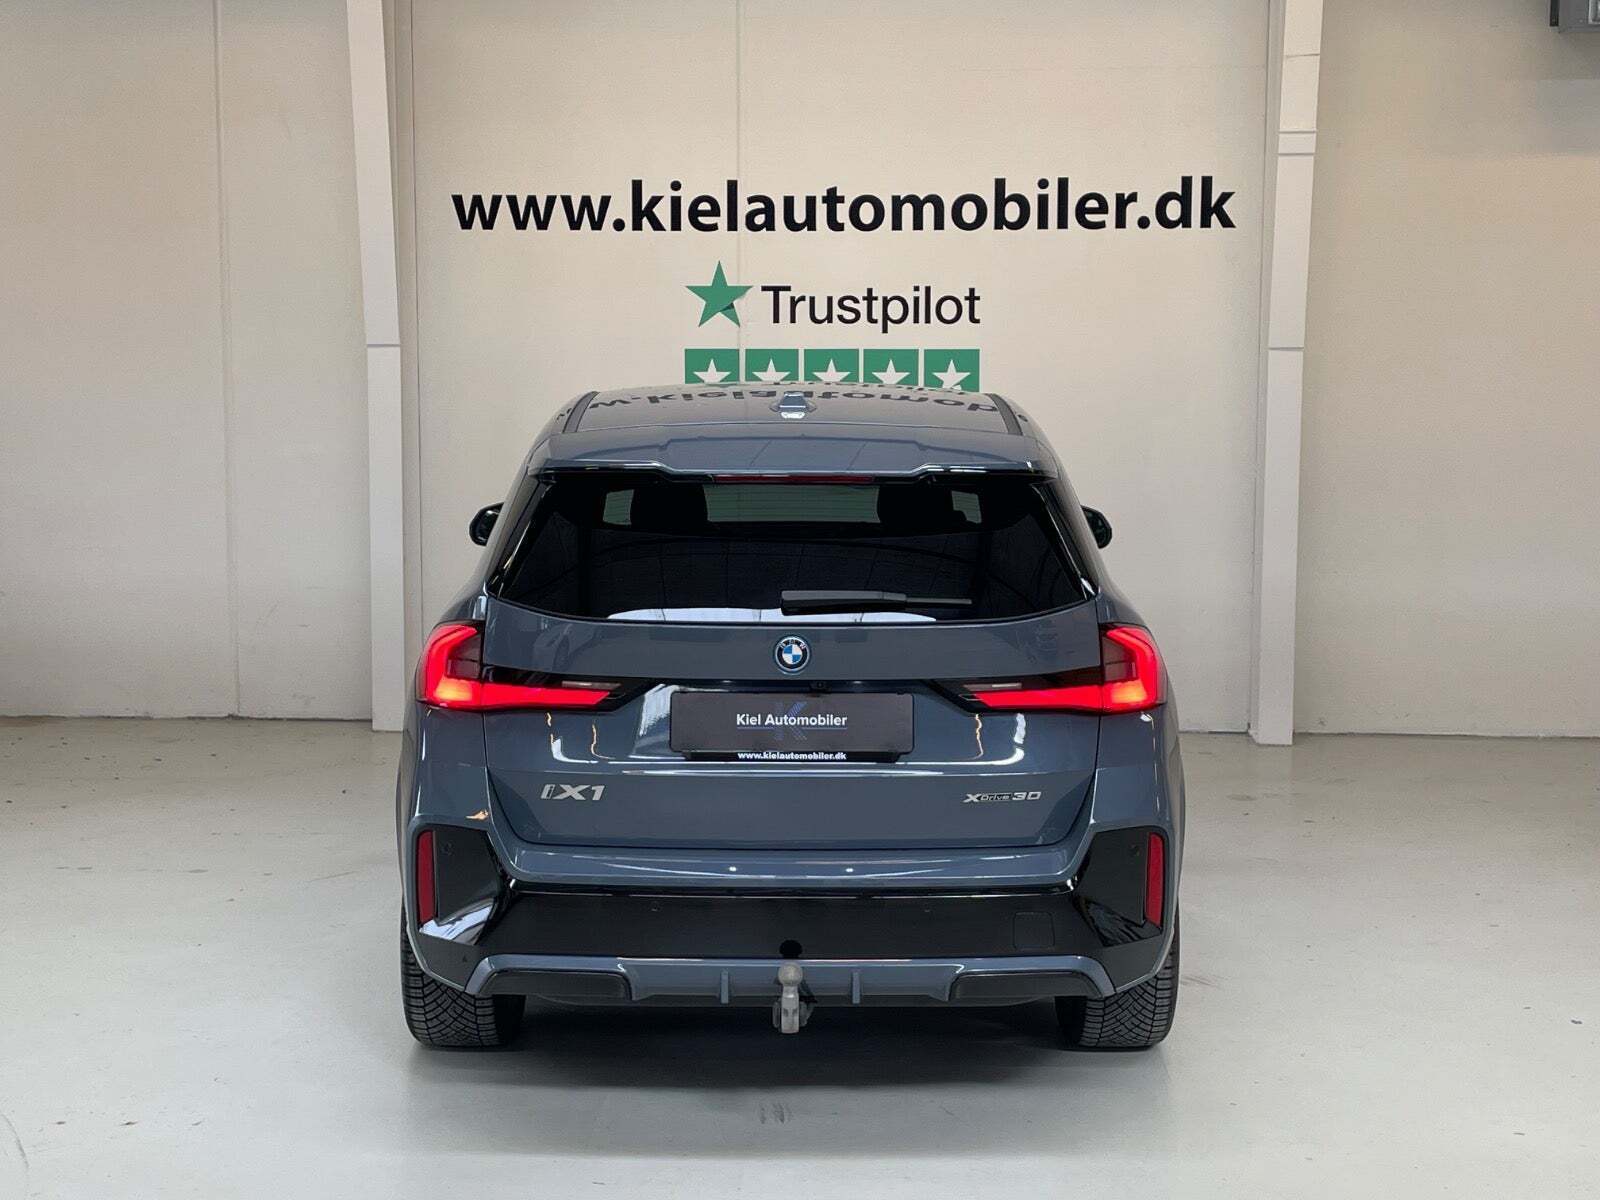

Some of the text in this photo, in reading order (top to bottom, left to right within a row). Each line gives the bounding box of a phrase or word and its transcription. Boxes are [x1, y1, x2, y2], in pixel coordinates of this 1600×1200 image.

[451, 176, 1236, 233] www.kielautomobiler.dk
[762, 285, 982, 334] Trustpilot
[736, 713, 848, 727] Kiel Automobiler
[737, 751, 847, 761] www.kielautomobiler.dk
[540, 783, 605, 800] iX1
